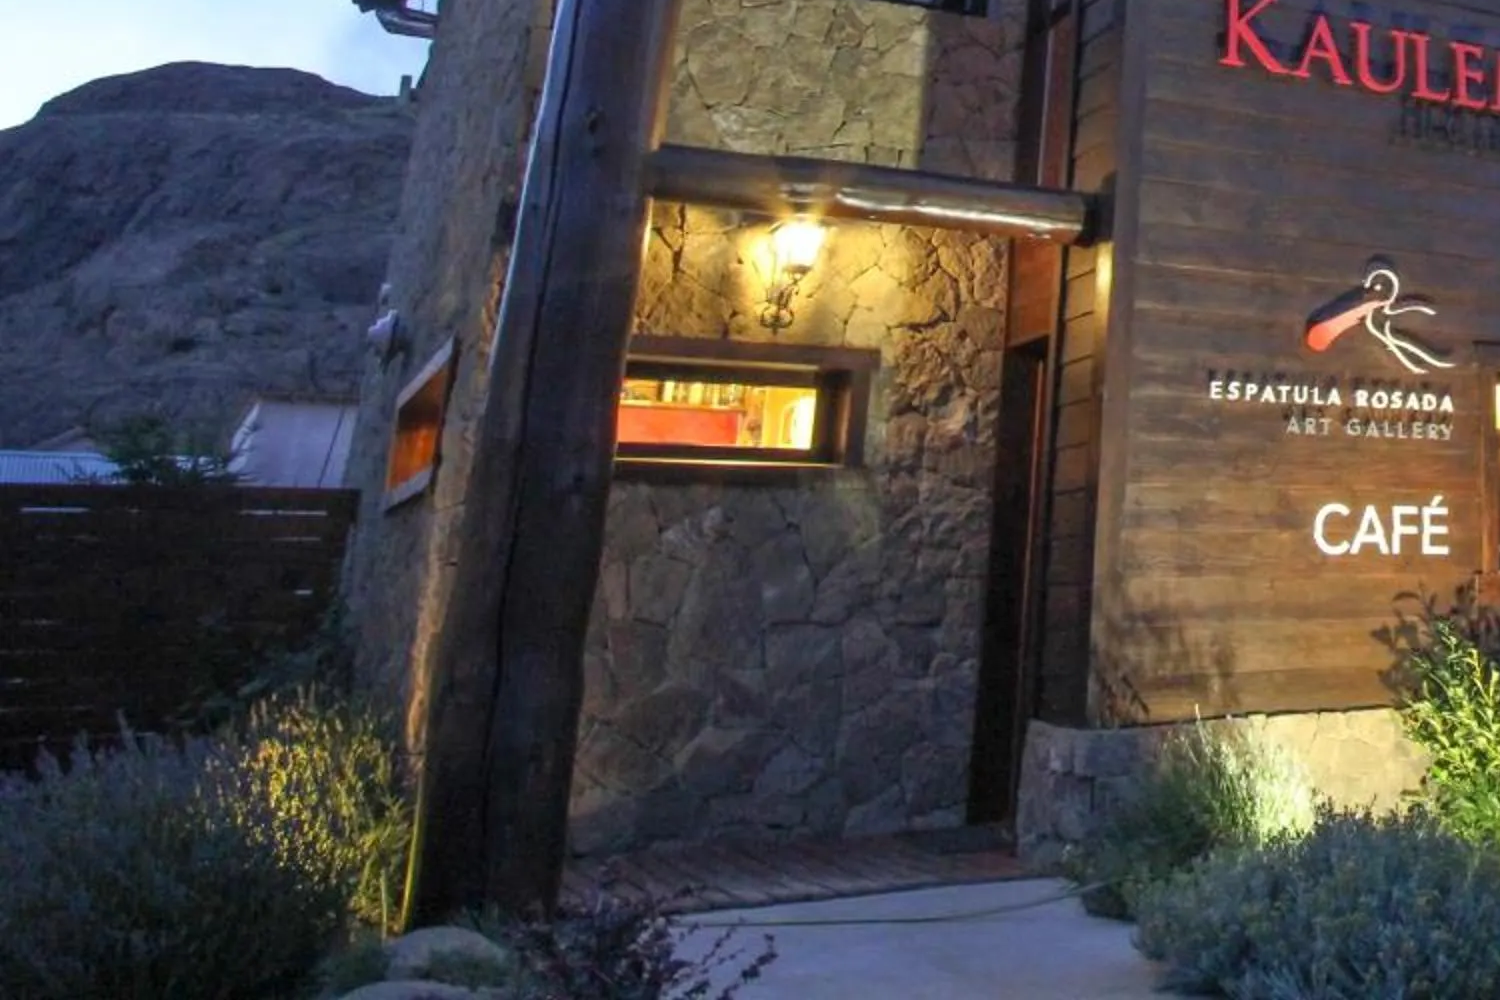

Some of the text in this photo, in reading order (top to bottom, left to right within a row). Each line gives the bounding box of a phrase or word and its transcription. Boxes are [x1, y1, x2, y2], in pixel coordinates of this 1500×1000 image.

[1208, 380, 1454, 413] ESPATULA ROSADA
[1286, 415, 1455, 440] ART GALLERY
[1313, 495, 1450, 555] CAFÉ
